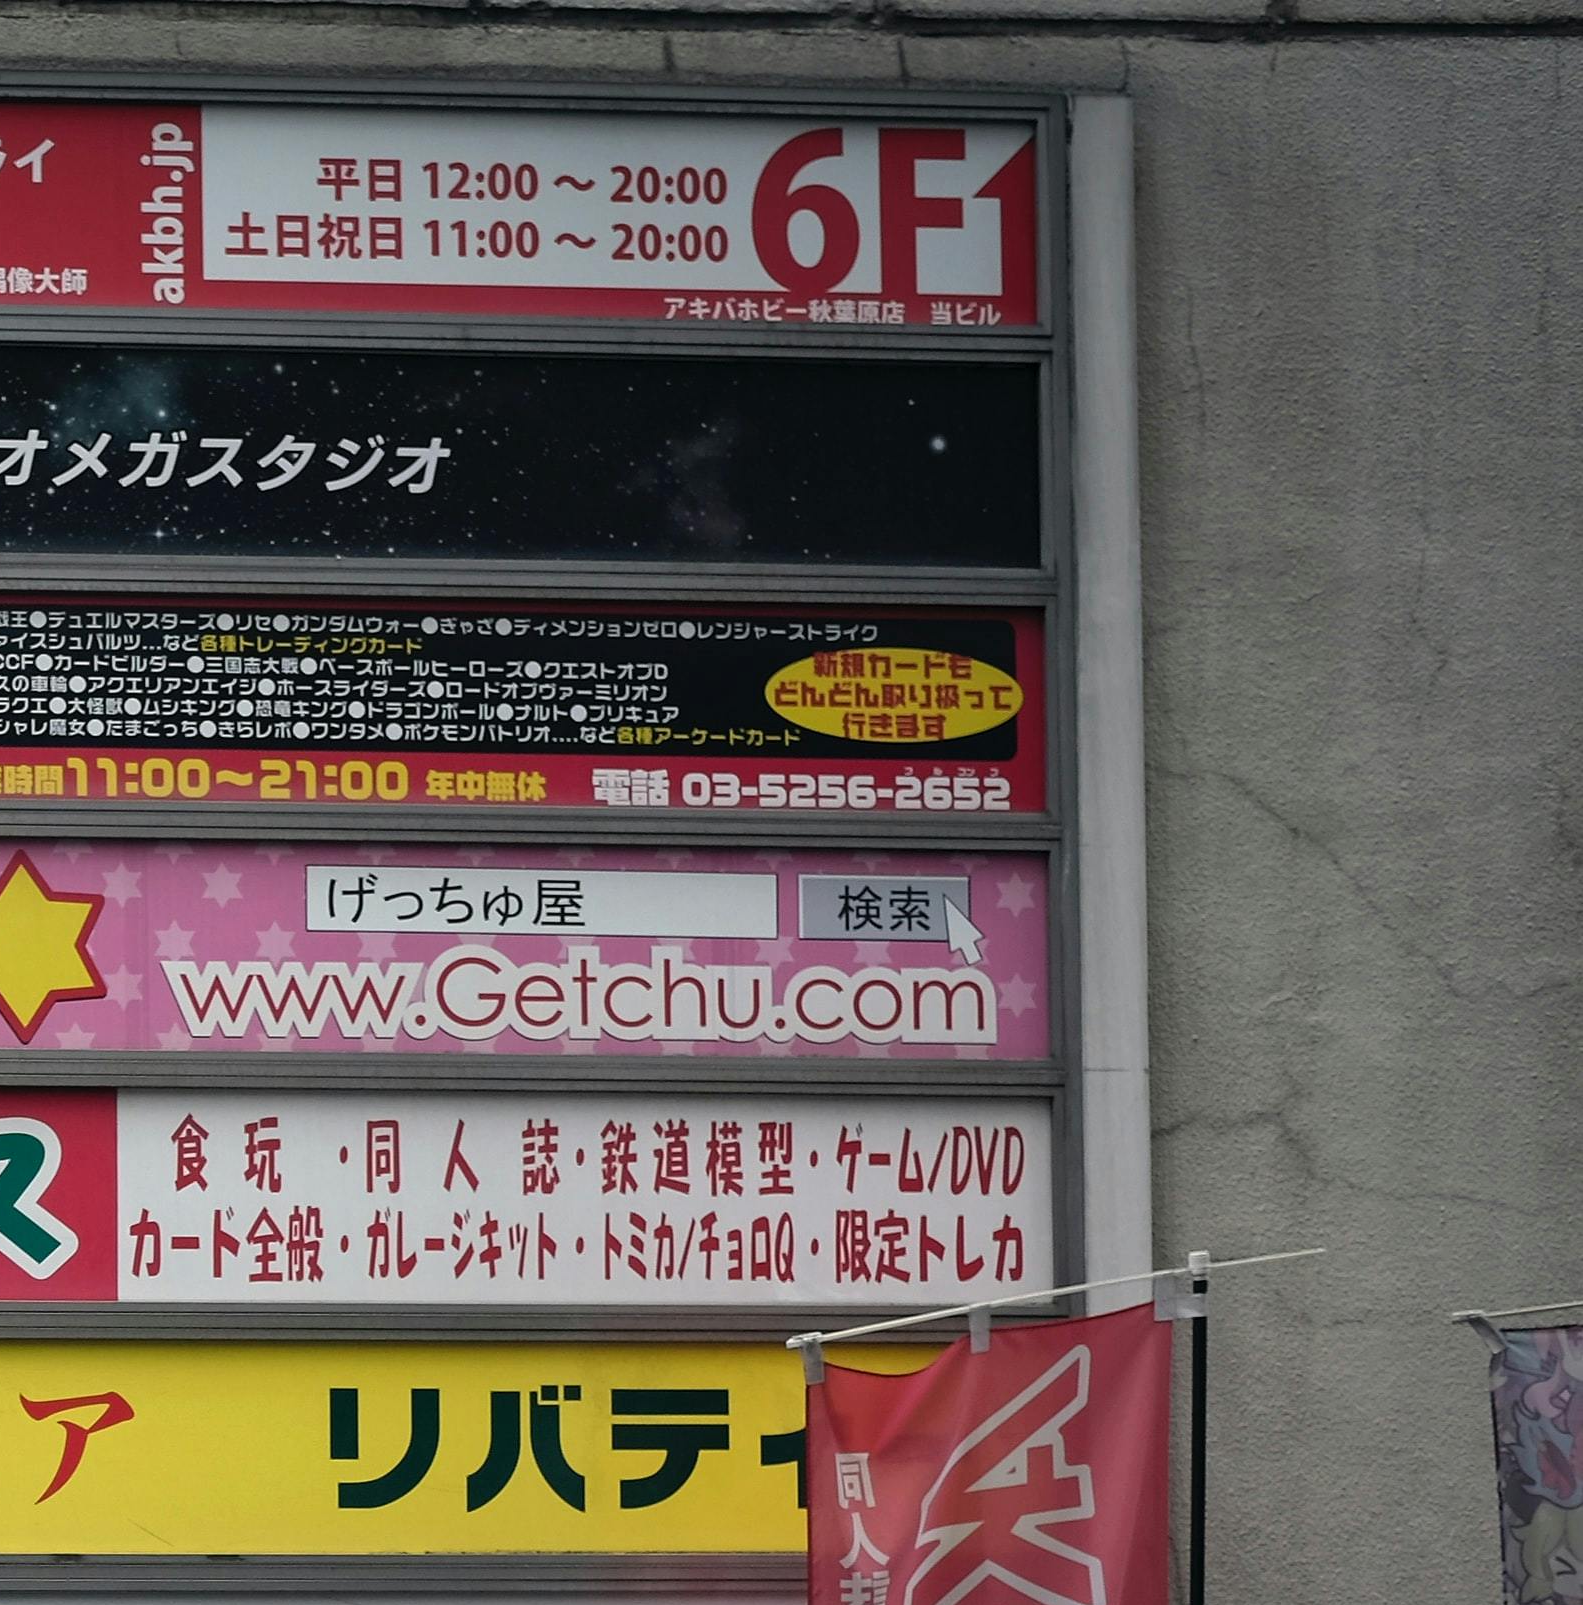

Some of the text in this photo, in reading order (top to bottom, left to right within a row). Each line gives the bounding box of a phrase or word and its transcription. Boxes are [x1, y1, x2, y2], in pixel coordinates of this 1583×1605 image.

[317, 158, 404, 202] 平日
[423, 161, 539, 202] 12:00
[611, 165, 729, 205] 20:00
[141, 121, 194, 305] akbh.jp
[225, 214, 404, 260] 土日祝日
[423, 219, 539, 259] 11:00
[611, 222, 729, 263] 20:00
[663, 296, 1002, 327] アキバホビー秋葉原店 当ビル
[813, 651, 974, 680] 新規カードも
[842, 713, 947, 741] 行きます
[425, 769, 547, 802] 年中無休
[592, 768, 1011, 812] 電話 03-5256-2652
[327, 876, 587, 930] げっちゅ屋
[837, 885, 932, 934] 検索
[171, 950, 991, 1036] www.Getchu.com
